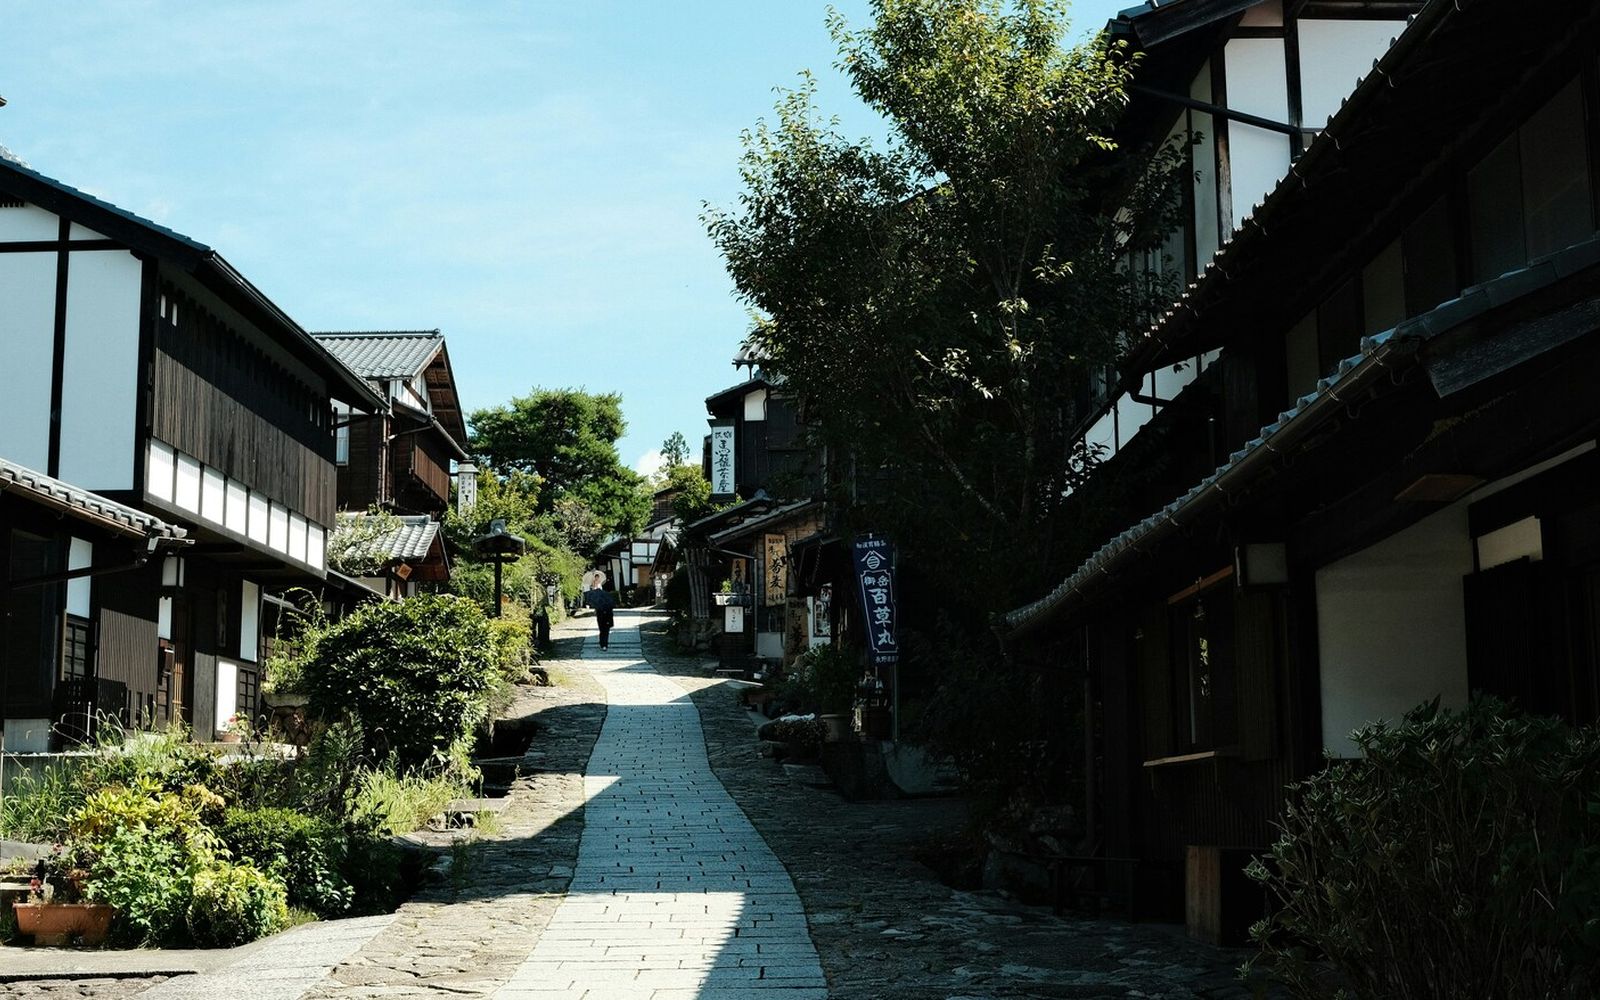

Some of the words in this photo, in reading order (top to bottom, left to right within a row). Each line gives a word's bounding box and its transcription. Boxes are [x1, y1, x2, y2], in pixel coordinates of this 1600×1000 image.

[864, 575, 889, 587] 御岳
[868, 588, 896, 646] 百草丸
